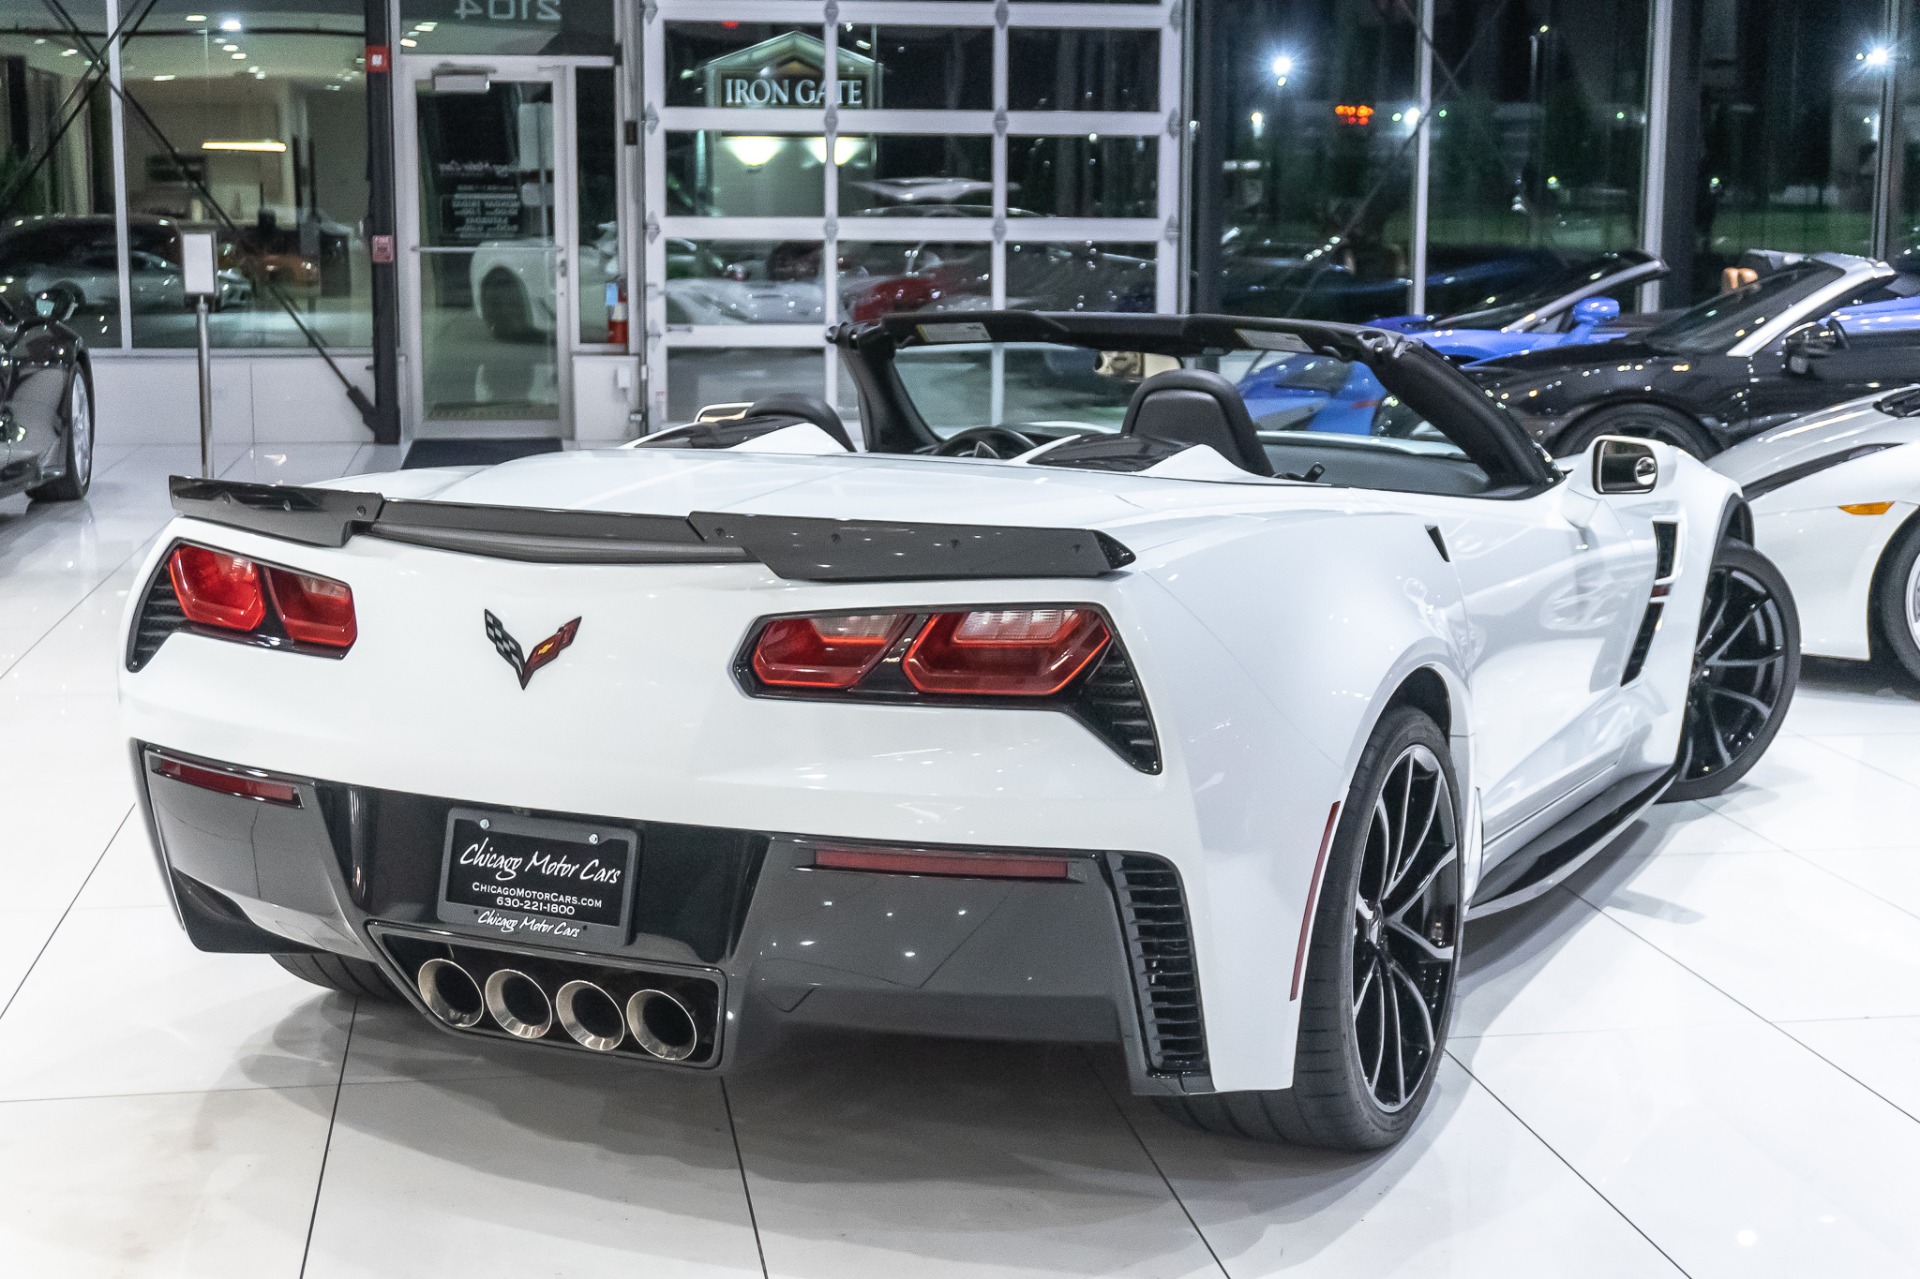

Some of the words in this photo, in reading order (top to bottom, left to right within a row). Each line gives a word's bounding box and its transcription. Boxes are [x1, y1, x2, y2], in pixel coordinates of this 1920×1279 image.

[724, 78, 789, 105] IRON
[459, 837, 523, 881] Chicago
[525, 851, 580, 877] Motor
[579, 859, 622, 884] Cars
[496, 896, 576, 916] 630-221-1800
[477, 909, 519, 933] Chicago
[519, 916, 555, 934] Motor
[553, 922, 580, 938] Cars
